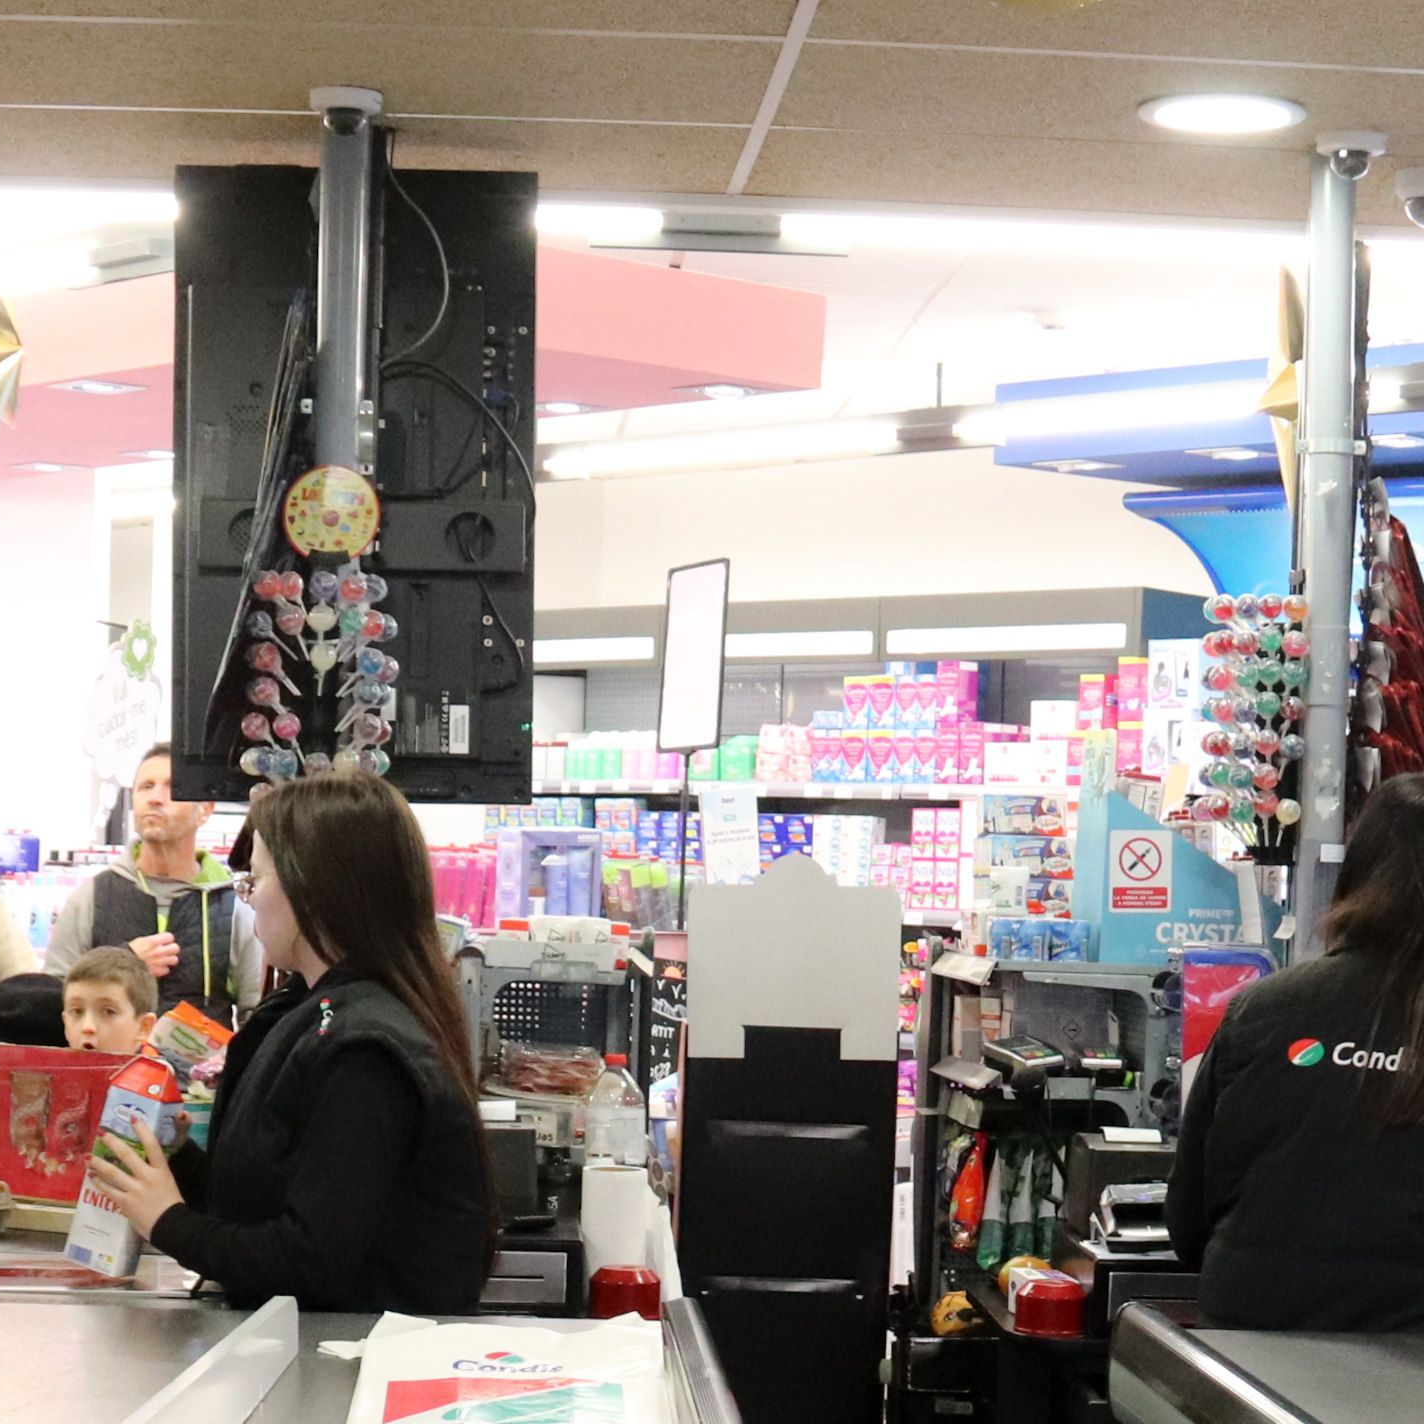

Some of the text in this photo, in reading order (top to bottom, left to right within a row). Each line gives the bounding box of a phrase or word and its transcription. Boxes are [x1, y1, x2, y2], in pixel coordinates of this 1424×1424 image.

[1189, 908, 1223, 919] PRIME
[1331, 1041, 1405, 1073] Cond
[452, 1359, 566, 1374] Condis
